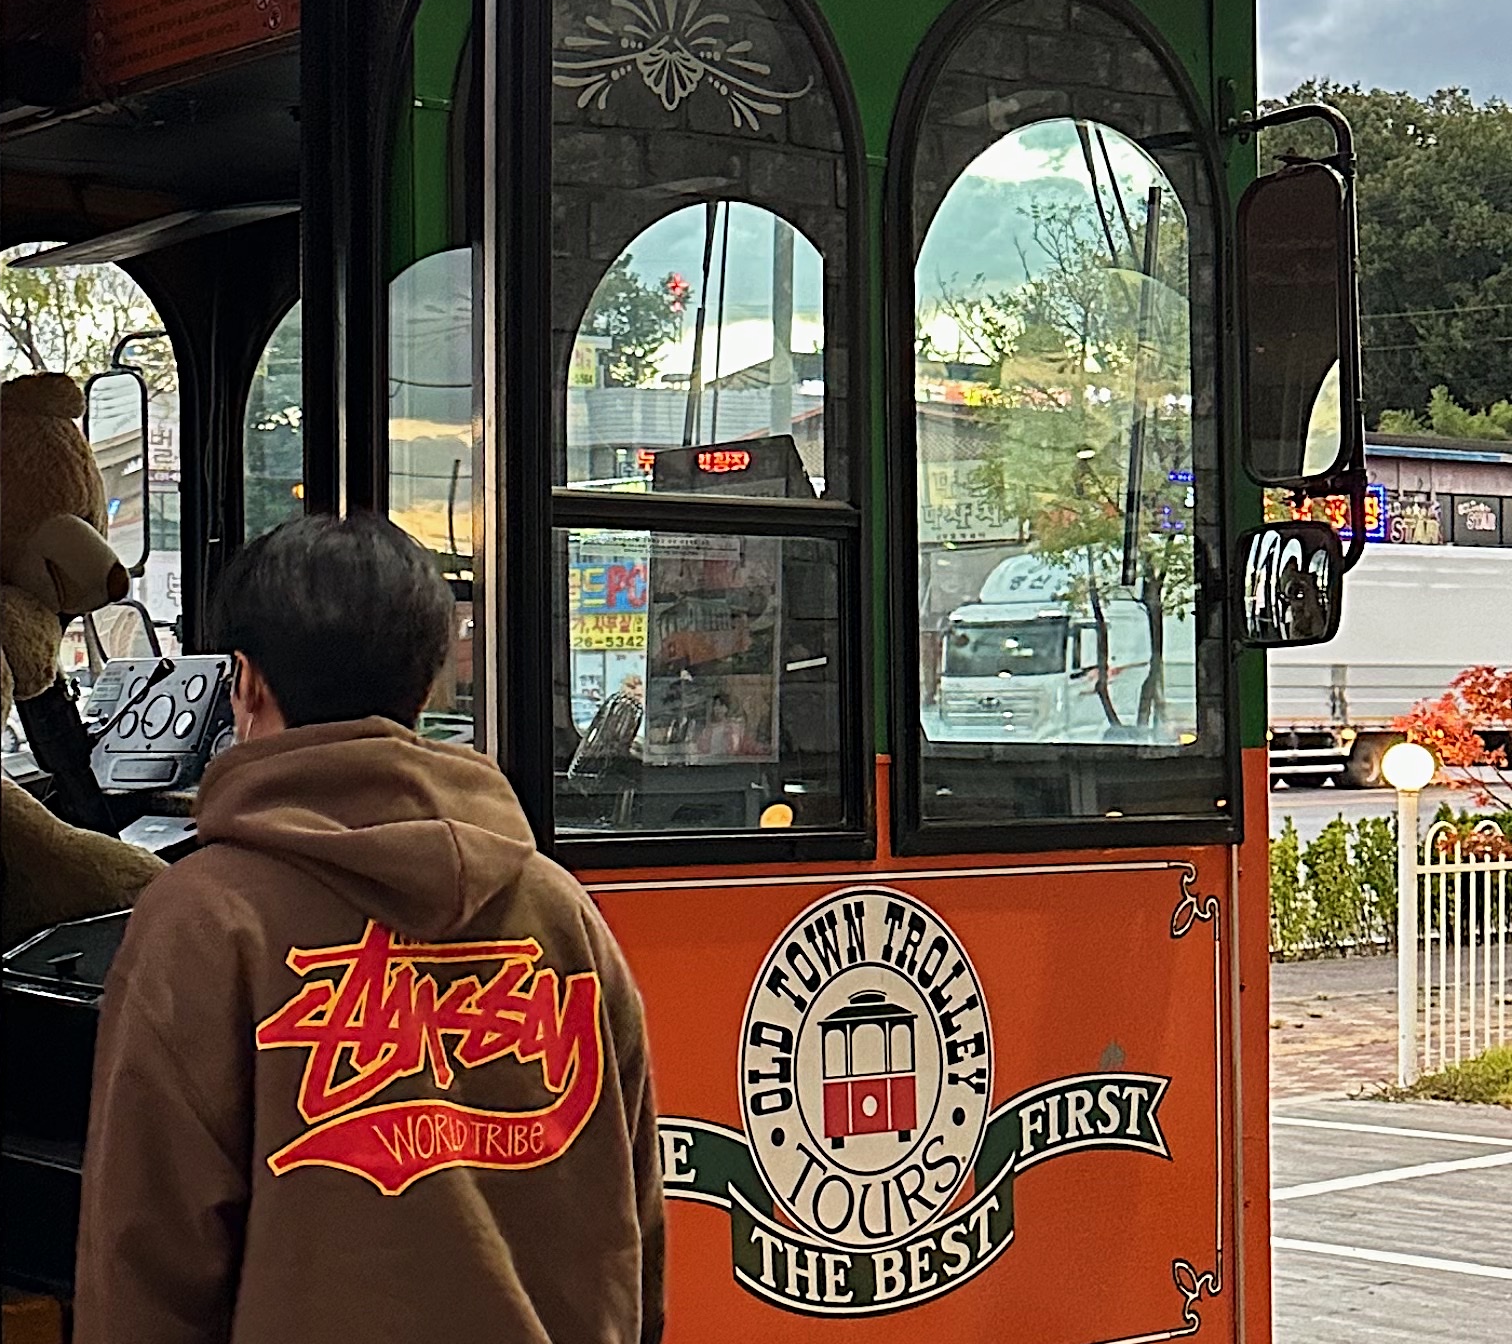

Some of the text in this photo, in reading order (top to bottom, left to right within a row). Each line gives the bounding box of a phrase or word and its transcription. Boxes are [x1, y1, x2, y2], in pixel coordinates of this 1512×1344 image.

[749, 900, 987, 1117] OLD TOWN TROLLEY
[372, 1113, 544, 1165] WORLD TRIBE
[1018, 1084, 1148, 1156] FIRST
[786, 1134, 962, 1240] TOURS
[750, 1197, 1001, 1303] THE BEST
